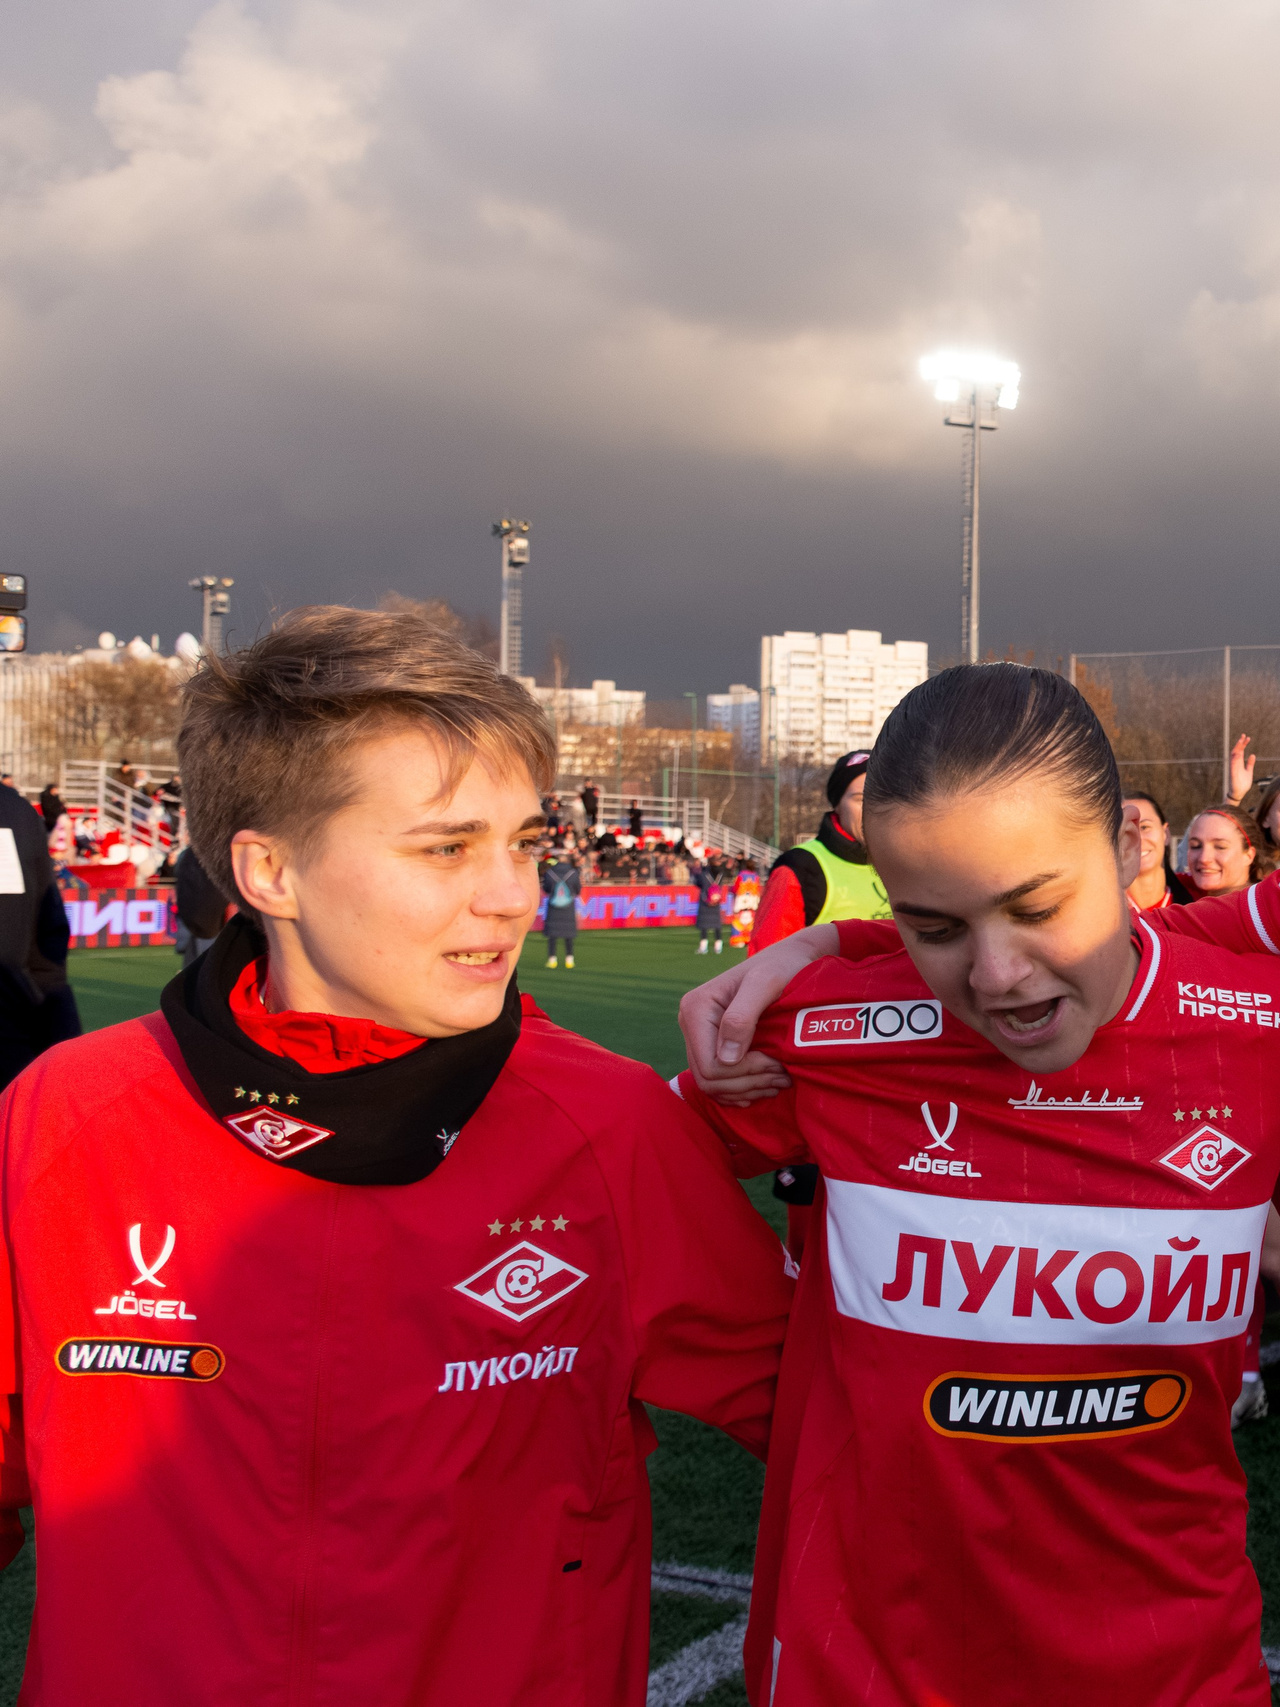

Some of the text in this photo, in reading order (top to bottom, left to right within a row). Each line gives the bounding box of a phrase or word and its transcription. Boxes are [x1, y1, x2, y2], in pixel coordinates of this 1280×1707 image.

[65, 900, 167, 936] ИО
[1178, 981, 1272, 1006] КИБЕР
[808, 1003, 939, 1039] ЭКТО 100
[898, 1152, 982, 1178] JÖGEL
[882, 1233, 1251, 1324] ЛУКОЙЛ
[95, 1290, 197, 1320] JÖGEL
[68, 1344, 190, 1373] WINLINE
[438, 1346, 579, 1393] ЛУКОЙЛ
[949, 1384, 1141, 1428] WINLINE
